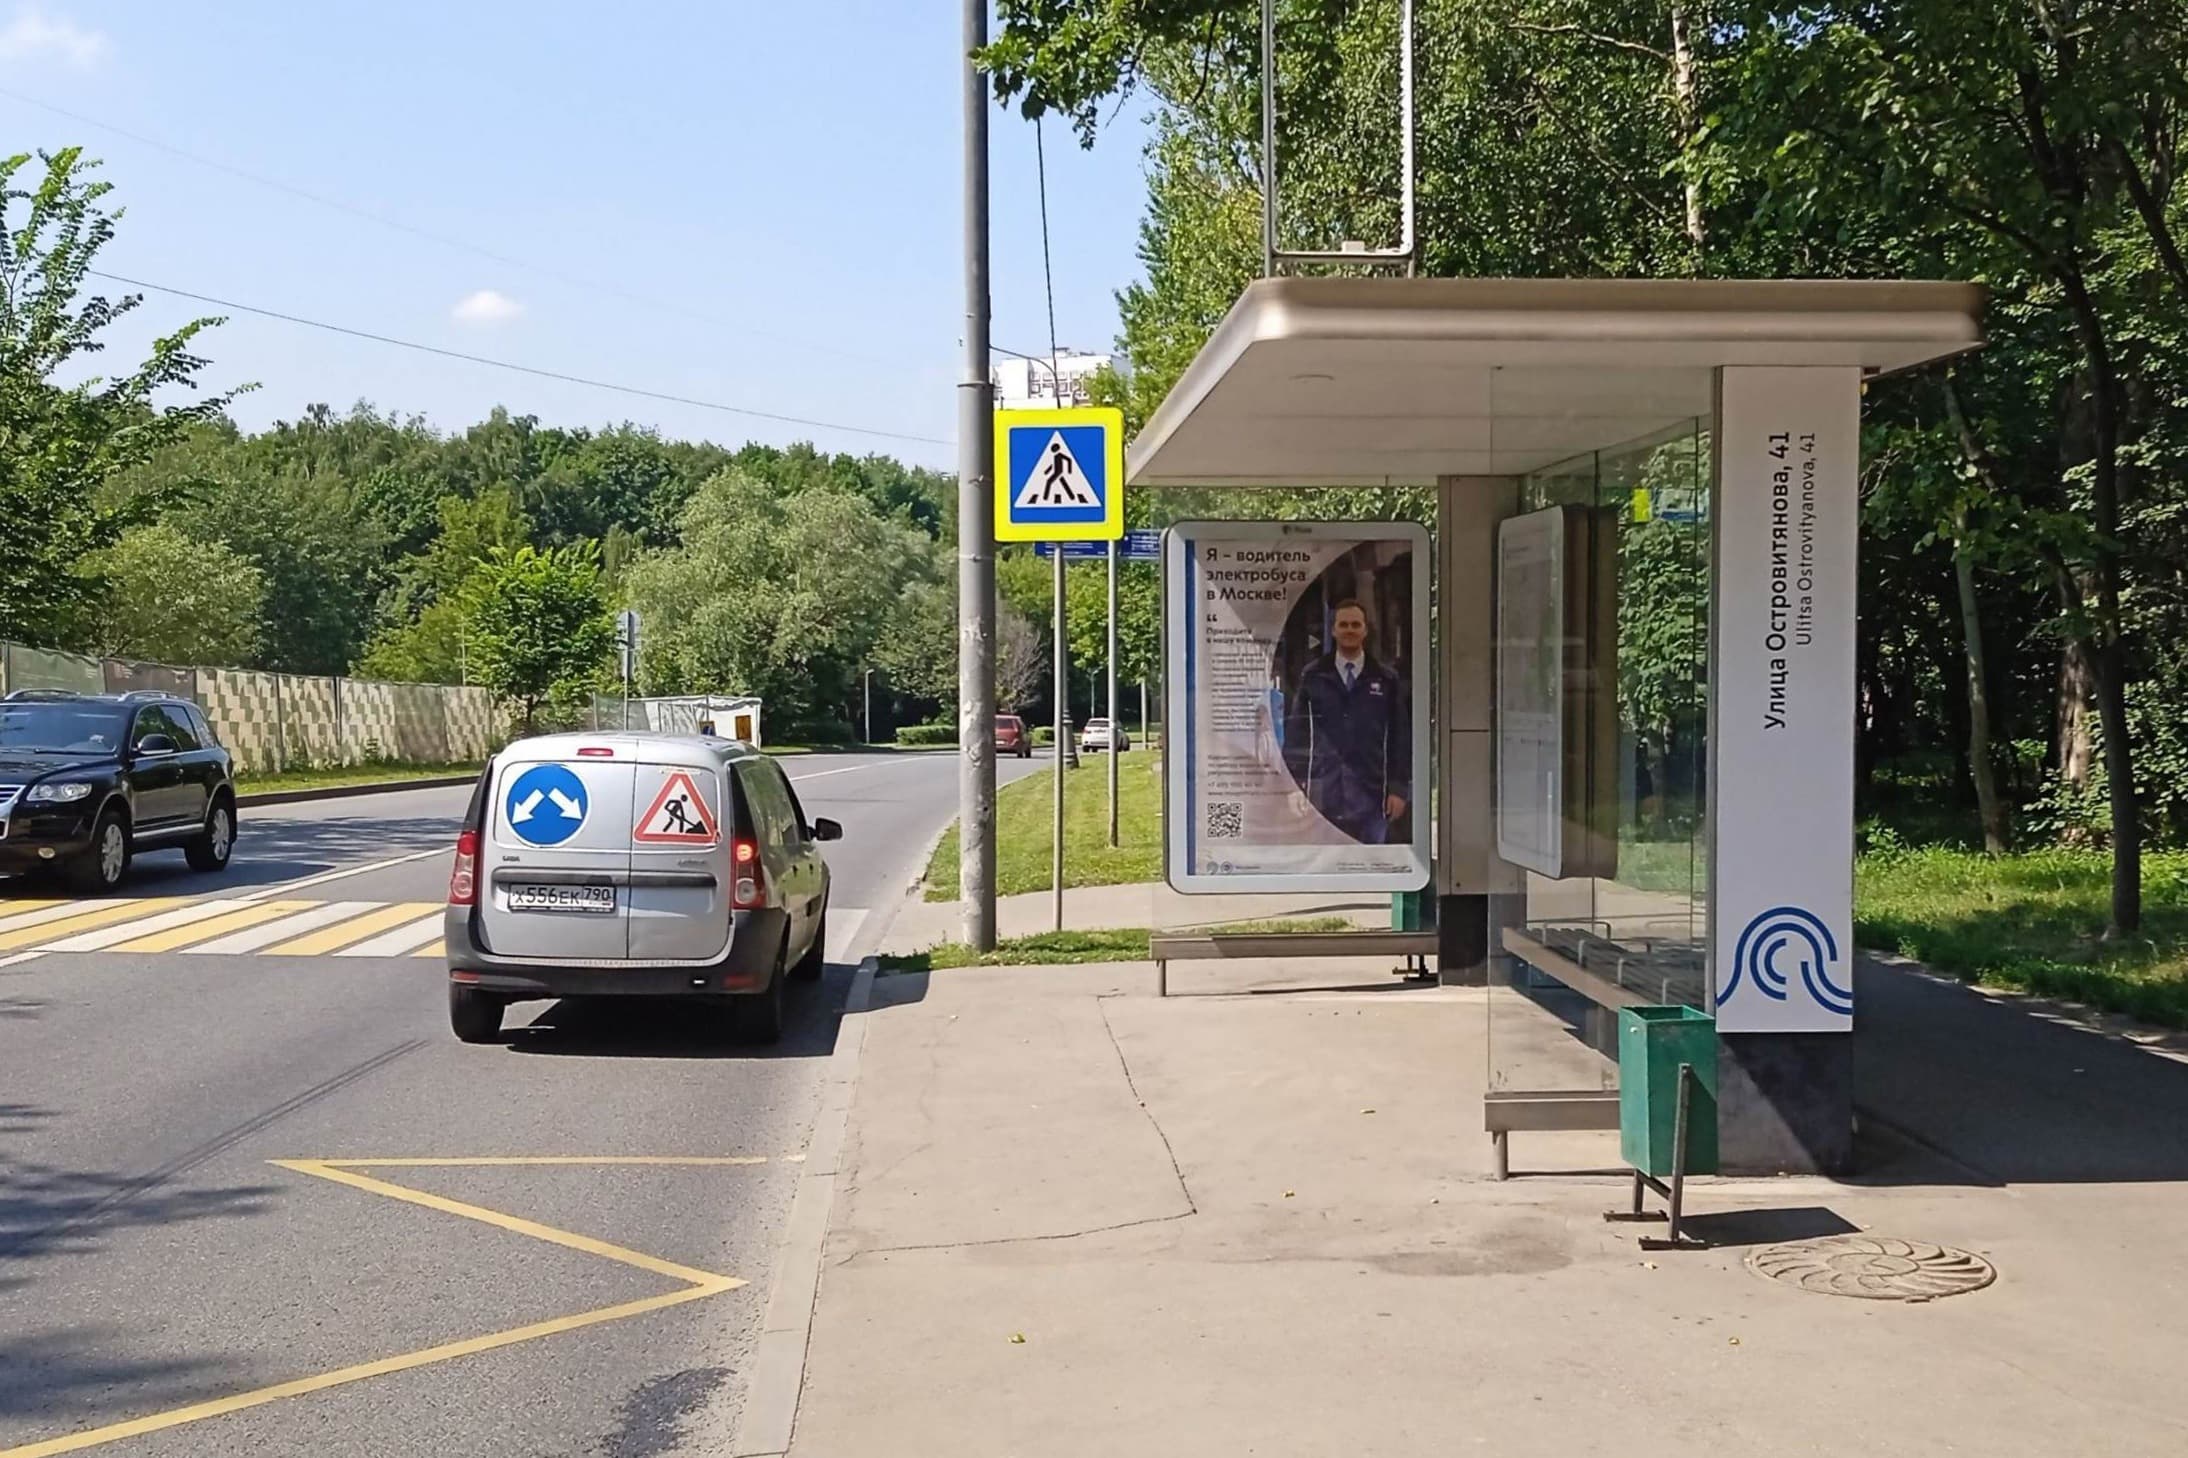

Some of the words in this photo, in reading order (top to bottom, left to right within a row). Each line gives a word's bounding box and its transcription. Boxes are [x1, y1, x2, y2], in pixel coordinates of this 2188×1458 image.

[1768, 431, 1790, 459] 41
[1800, 432, 1815, 453] 41
[1797, 457, 1817, 591] Ostrovityanova,
[1206, 548, 1218, 561] Я
[1236, 551, 1311, 563] водитель
[1766, 465, 1793, 652] Островитянова,
[1206, 567, 1306, 584] электробуса
[1206, 590, 1216, 600] в
[1220, 586, 1287, 600] Москве!
[1796, 594, 1812, 646] Ulitsa
[1764, 657, 1789, 729] Улица
